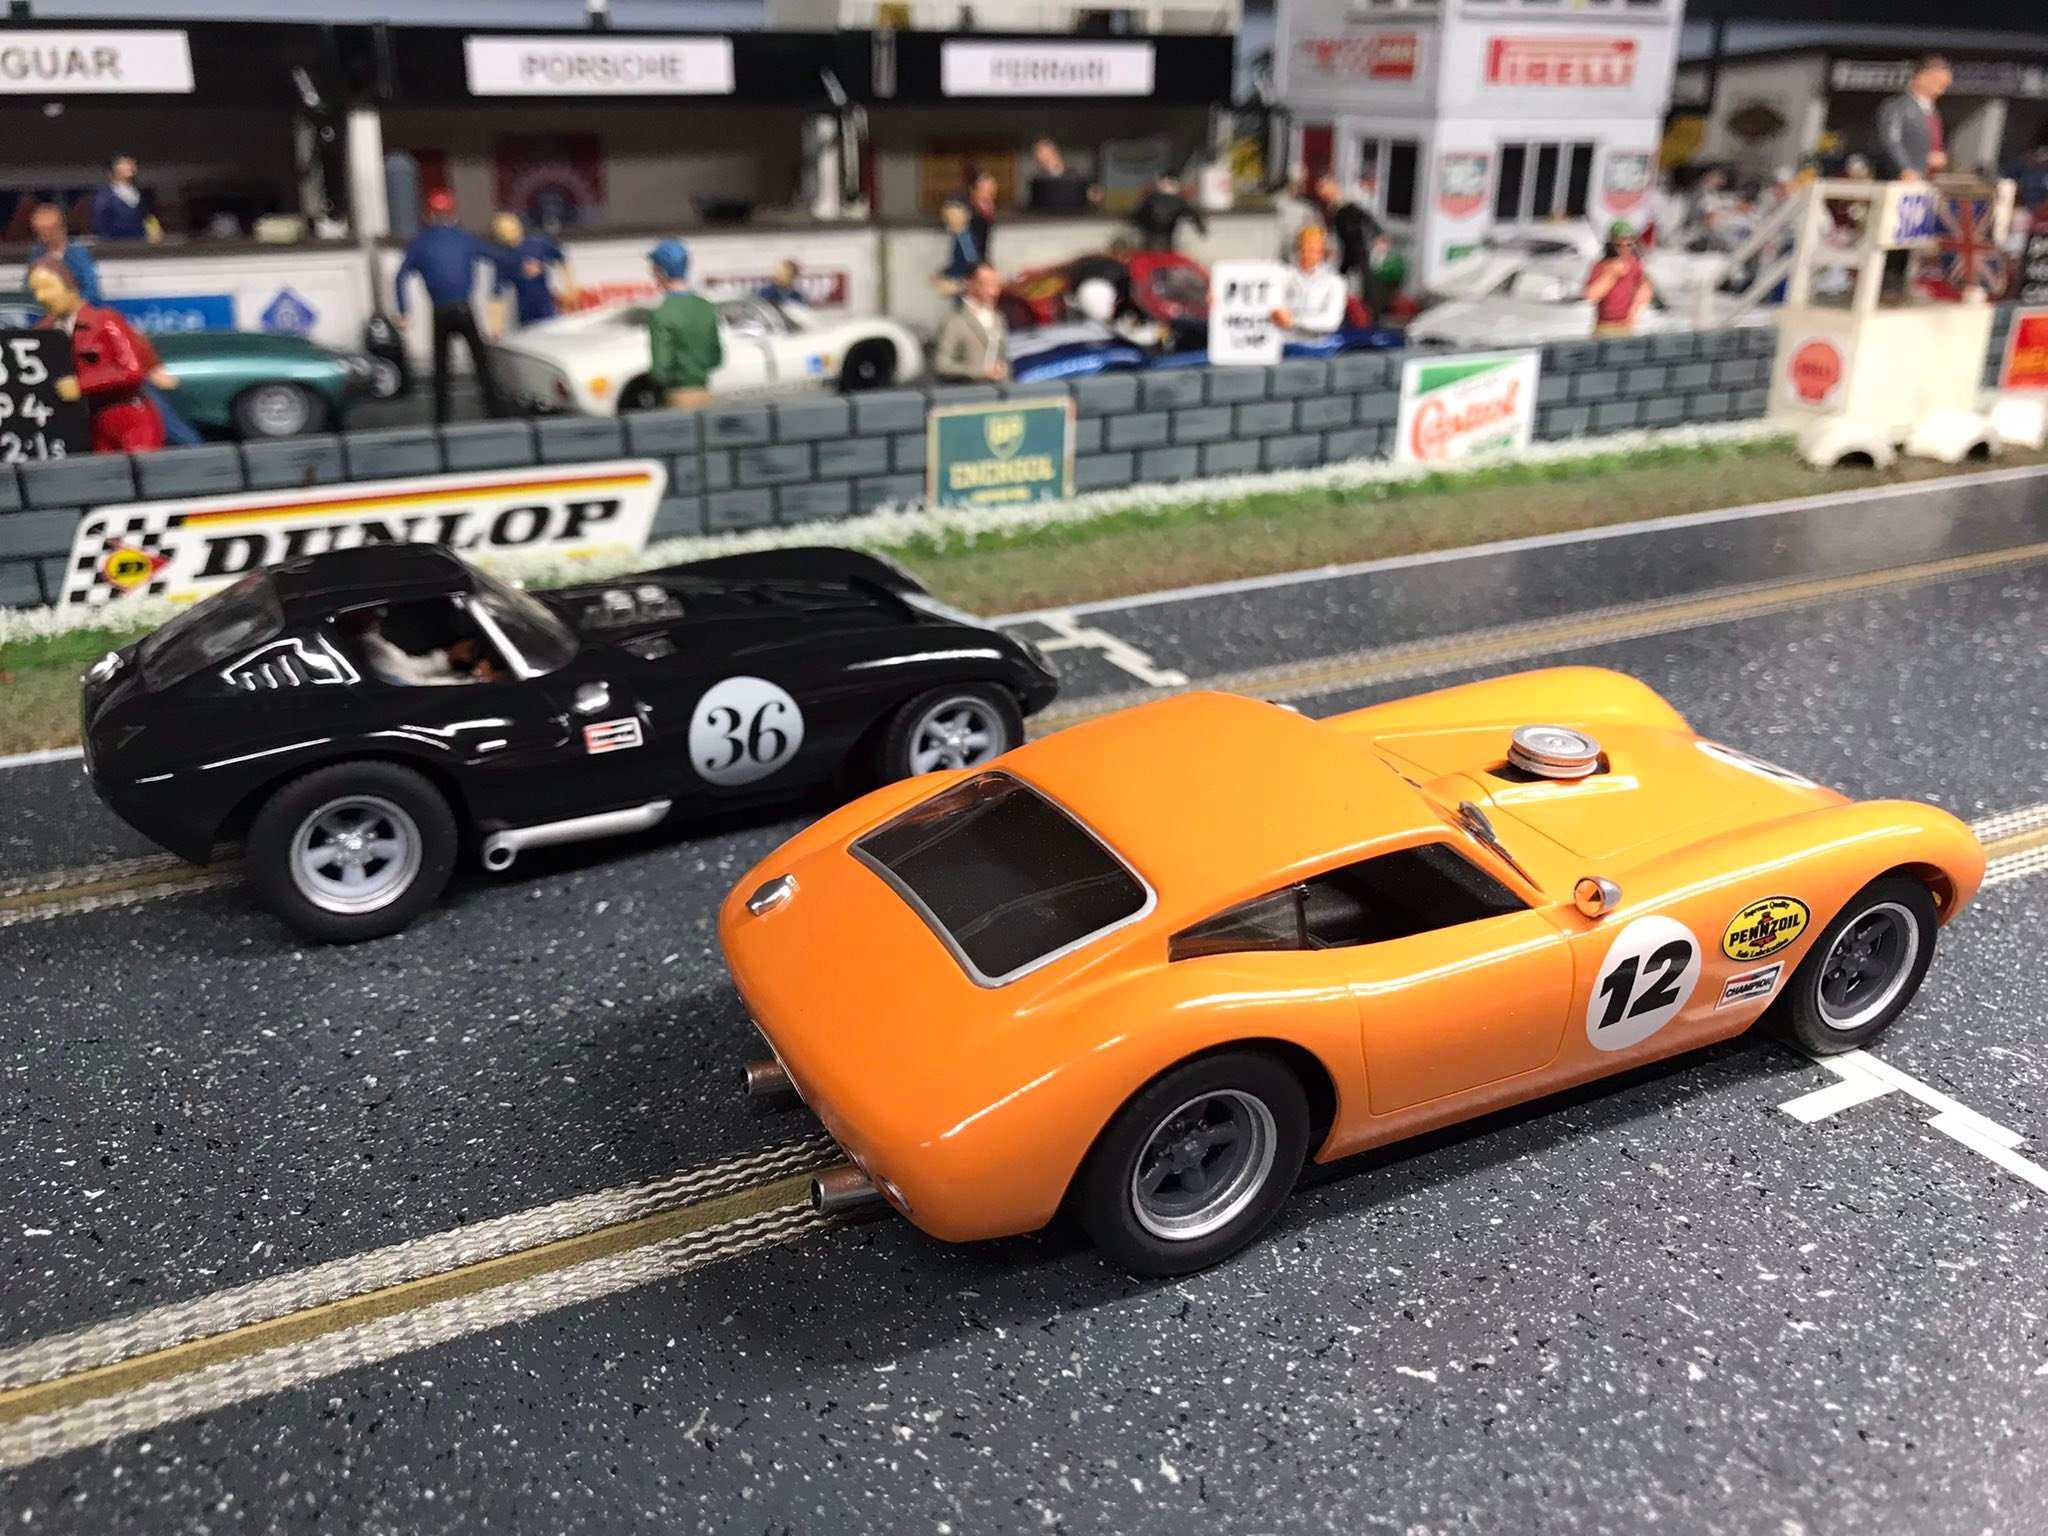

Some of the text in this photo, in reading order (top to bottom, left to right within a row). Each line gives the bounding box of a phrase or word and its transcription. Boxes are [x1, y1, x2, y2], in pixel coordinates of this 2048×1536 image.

[0, 46, 122, 80] GUAR
[1486, 37, 1638, 84] PIRELLI
[193, 500, 620, 580] DUNLOP
[705, 701, 788, 774] 36
[1728, 913, 1801, 947] PENNZOIL
[1598, 939, 1693, 1030] 12
[1725, 978, 1775, 998] CHAMPION
